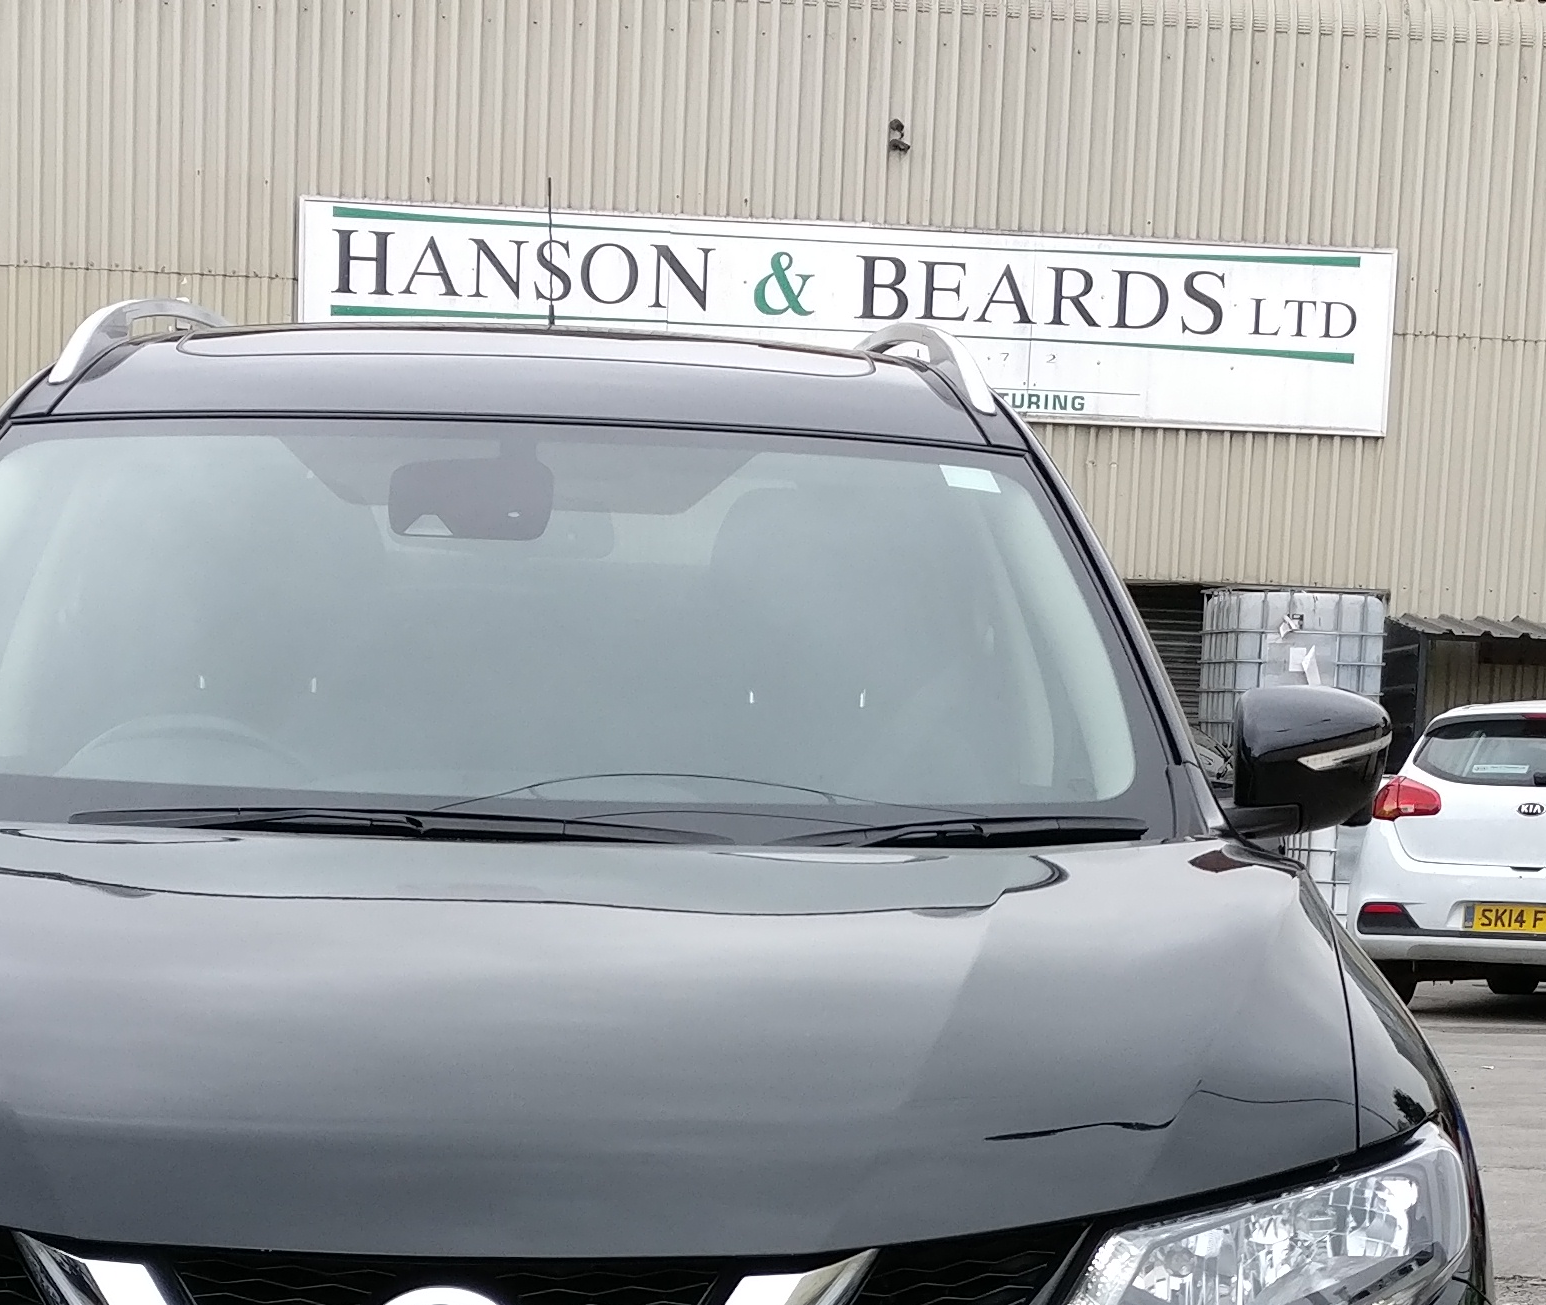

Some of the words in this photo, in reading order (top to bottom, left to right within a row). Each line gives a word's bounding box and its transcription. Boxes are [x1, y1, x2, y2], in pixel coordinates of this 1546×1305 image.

[330, 228, 717, 312] HANSON
[753, 251, 815, 317] &
[854, 254, 1226, 335] BEARDS
[1249, 298, 1358, 340] LTD
[1520, 804, 1543, 814] KIA
[1479, 908, 1527, 928] SK14
